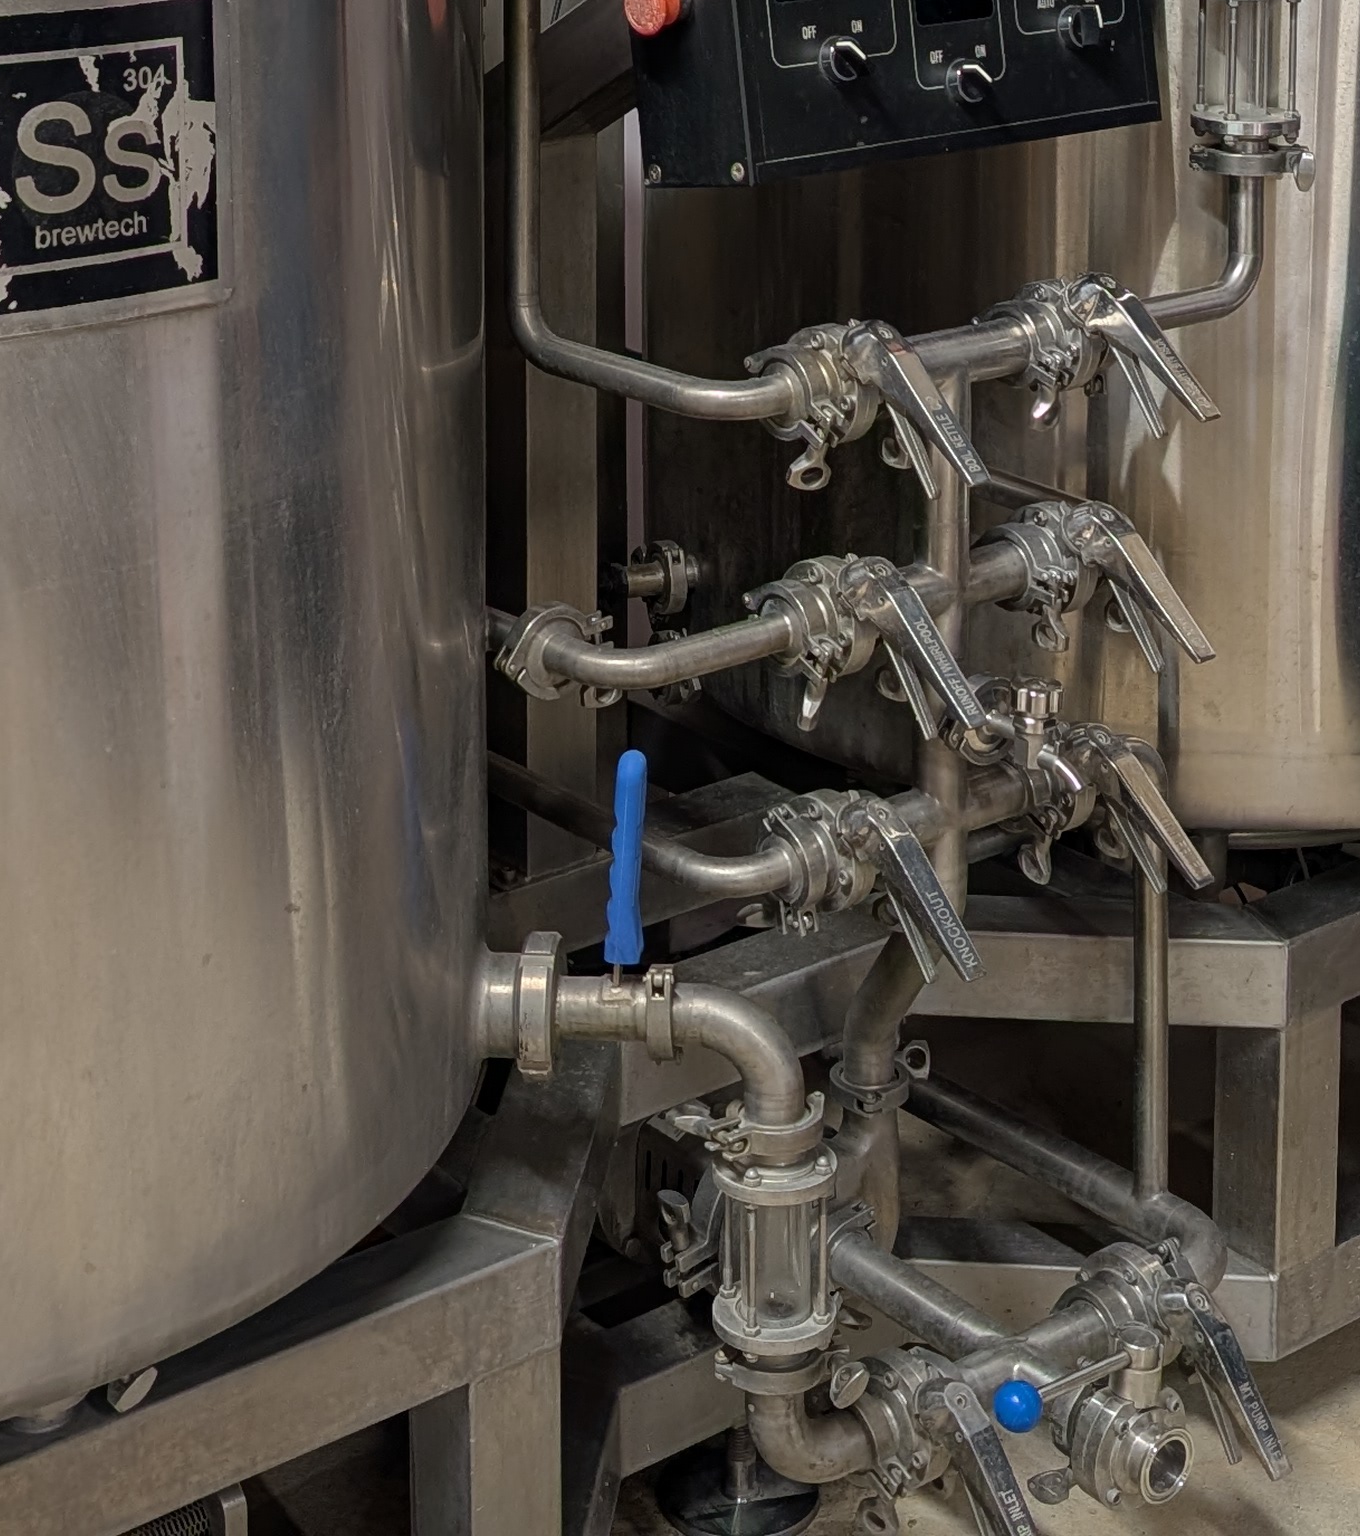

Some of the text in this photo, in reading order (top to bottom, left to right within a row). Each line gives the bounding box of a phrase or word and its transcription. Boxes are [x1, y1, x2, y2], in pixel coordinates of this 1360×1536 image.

[802, 25, 816, 40] OFF
[851, 20, 862, 33] ON
[930, 50, 943, 64] OFF
[975, 45, 986, 58] ON
[122, 65, 167, 93] 304
[15, 101, 164, 215] Ss
[35, 211, 148, 250] brewtech
[936, 413, 966, 449] KETTLE
[960, 450, 982, 473] BOIL
[925, 891, 978, 968] KNOCKOUT
[1239, 1382, 1282, 1462] MT PUMP INLE
[998, 1489, 1025, 1522] INLET
